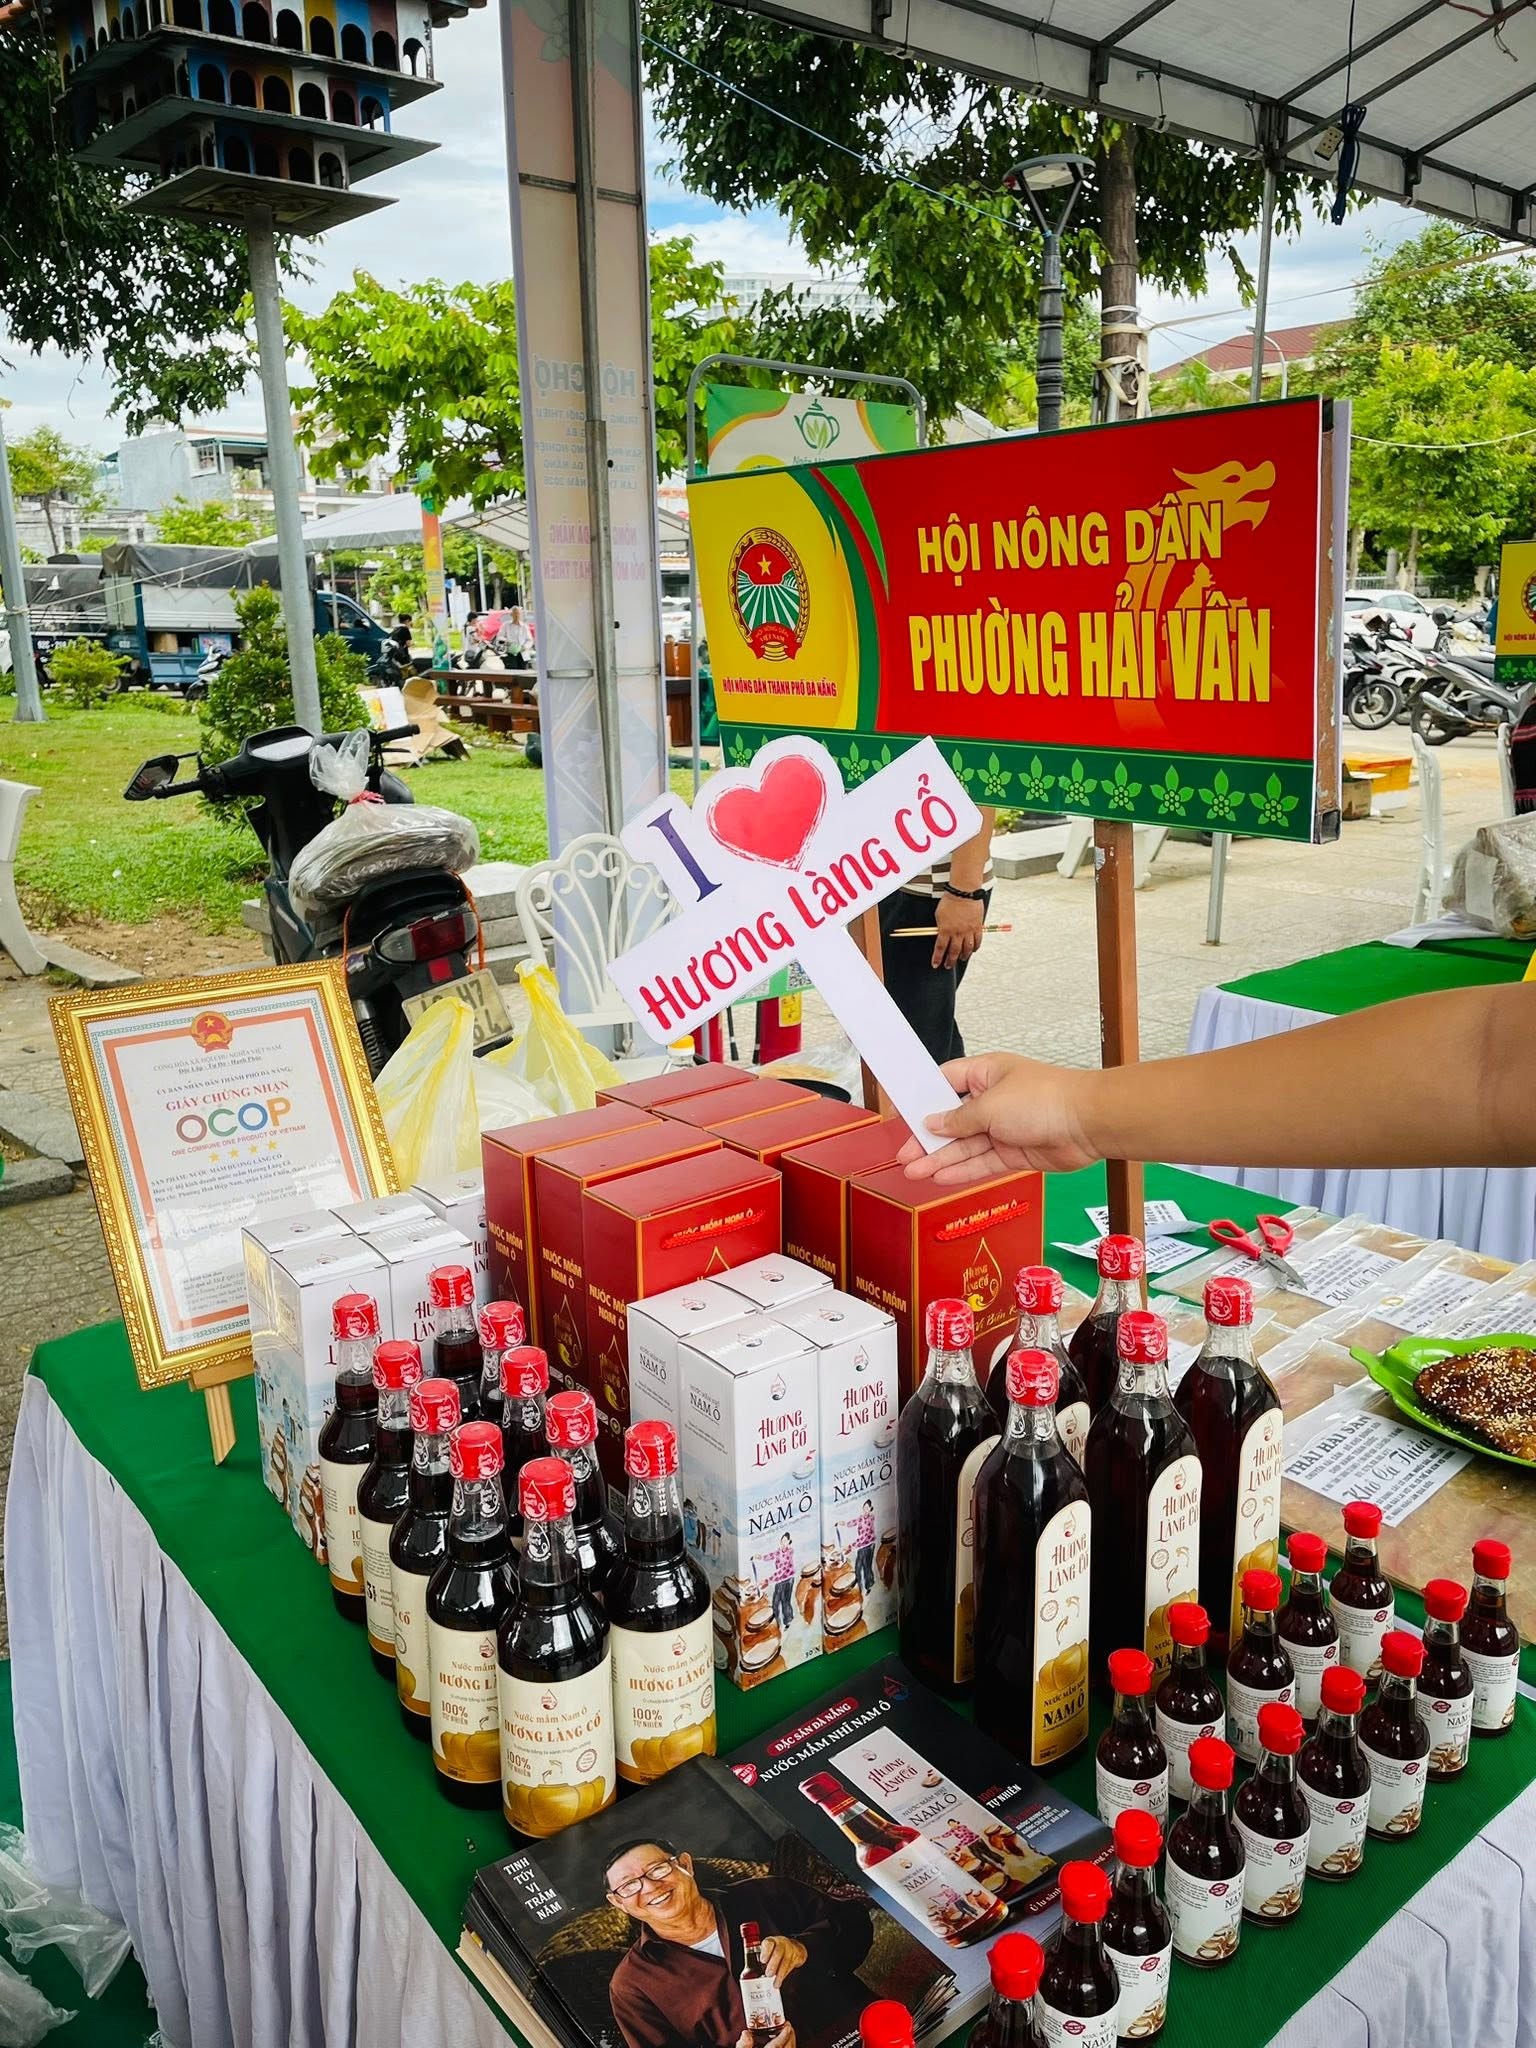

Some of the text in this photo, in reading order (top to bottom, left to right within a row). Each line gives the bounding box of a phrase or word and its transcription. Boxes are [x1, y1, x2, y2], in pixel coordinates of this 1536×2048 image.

[918, 494, 1223, 577] HỘI NÔNG DÂN
[909, 582, 1271, 703] PHƯỜNG HẢI VÂN
[723, 677, 837, 697] HỘI NÔNG DÂN THÀNH PHỐ ĐÀ NẴNG
[647, 809, 722, 902] I
[166, 1080, 289, 1112] GIẤY CHỨNG NHẬN
[176, 1097, 291, 1143] OCOP
[172, 1124, 307, 1157] ONE COMMUNE ONE PRODUCT OF VIETNAM
[543, 1247, 583, 1279] NƯỚC MẮM
[787, 1241, 836, 1275] NƯỚC MẮM
[551, 1267, 567, 1286] NAM
[589, 1284, 627, 1316] NƯỚC MẮ
[856, 1275, 907, 1313] NƯỚC MẮM
[598, 1306, 617, 1326] NAM
[639, 1352, 660, 1376] NAM
[690, 1391, 712, 1417] NAM
[843, 1380, 884, 1410] HƯƠNG
[758, 1409, 803, 1440] HƯƠNG
[836, 1394, 888, 1437] LÀNG CỔ
[751, 1436, 788, 1468] LÀNG
[791, 1418, 807, 1448] CỔ
[1252, 1440, 1282, 1468] HƯƠNG
[1284, 1413, 1372, 1476] THÁI HẢI SẢN
[833, 1466, 856, 1482] NƯỚC
[857, 1456, 878, 1472] MẮM
[833, 1475, 875, 1502] NAM
[878, 1460, 893, 1481] Ô
[1342, 1478, 1382, 1501] Khô
[1371, 1462, 1402, 1482] Cá
[748, 1497, 773, 1515] NƯỚC
[774, 1488, 796, 1505] MẮM
[748, 1504, 793, 1535] NAM
[798, 1492, 813, 1513] Ô
[1163, 1488, 1197, 1518] HƯƠNG
[1154, 1515, 1186, 1543] LÀNG
[1052, 1533, 1087, 1566] HƯƠNG
[1043, 1563, 1076, 1593] LÀNG
[643, 1664, 665, 1674] Nước
[1154, 1652, 1172, 1670] NA
[439, 1672, 481, 1691] HƯƠNG
[629, 1678, 674, 1692] HƯƠNG
[678, 1664, 705, 1687] LÀNG
[441, 1700, 469, 1718] 100%
[513, 1710, 534, 1723] Nước
[536, 1711, 559, 1724] mắm
[561, 1710, 580, 1723] Nam
[632, 1706, 662, 1721] 100%
[1043, 1688, 1085, 1729] NAM Ô
[504, 1709, 602, 1743] HƯƠNG LÀNG CỔ
[759, 1756, 799, 1783] NƯỚC
[796, 1742, 831, 1761] MẮM
[828, 1721, 855, 1743] NHĨ
[850, 1707, 882, 1729] NAM
[878, 1699, 892, 1711] Ô
[774, 1702, 852, 1752] ĐẶC SẢN ĐÀ NẴNG
[506, 1748, 531, 1770] 100%
[868, 1757, 905, 1783] HƯƠNG
[868, 1764, 918, 1797] LÀNG CỔ
[908, 1792, 958, 1827] NAM Ô
[985, 1783, 1022, 1810] TỰ NHIÊN
[503, 1857, 530, 1876] TINH
[513, 1868, 535, 1885] TÚY
[904, 1872, 932, 1892] NAM
[524, 1888, 557, 1910] TRĂM
[536, 1901, 562, 1920] NĂM
[1037, 1898, 1047, 1907] lu
